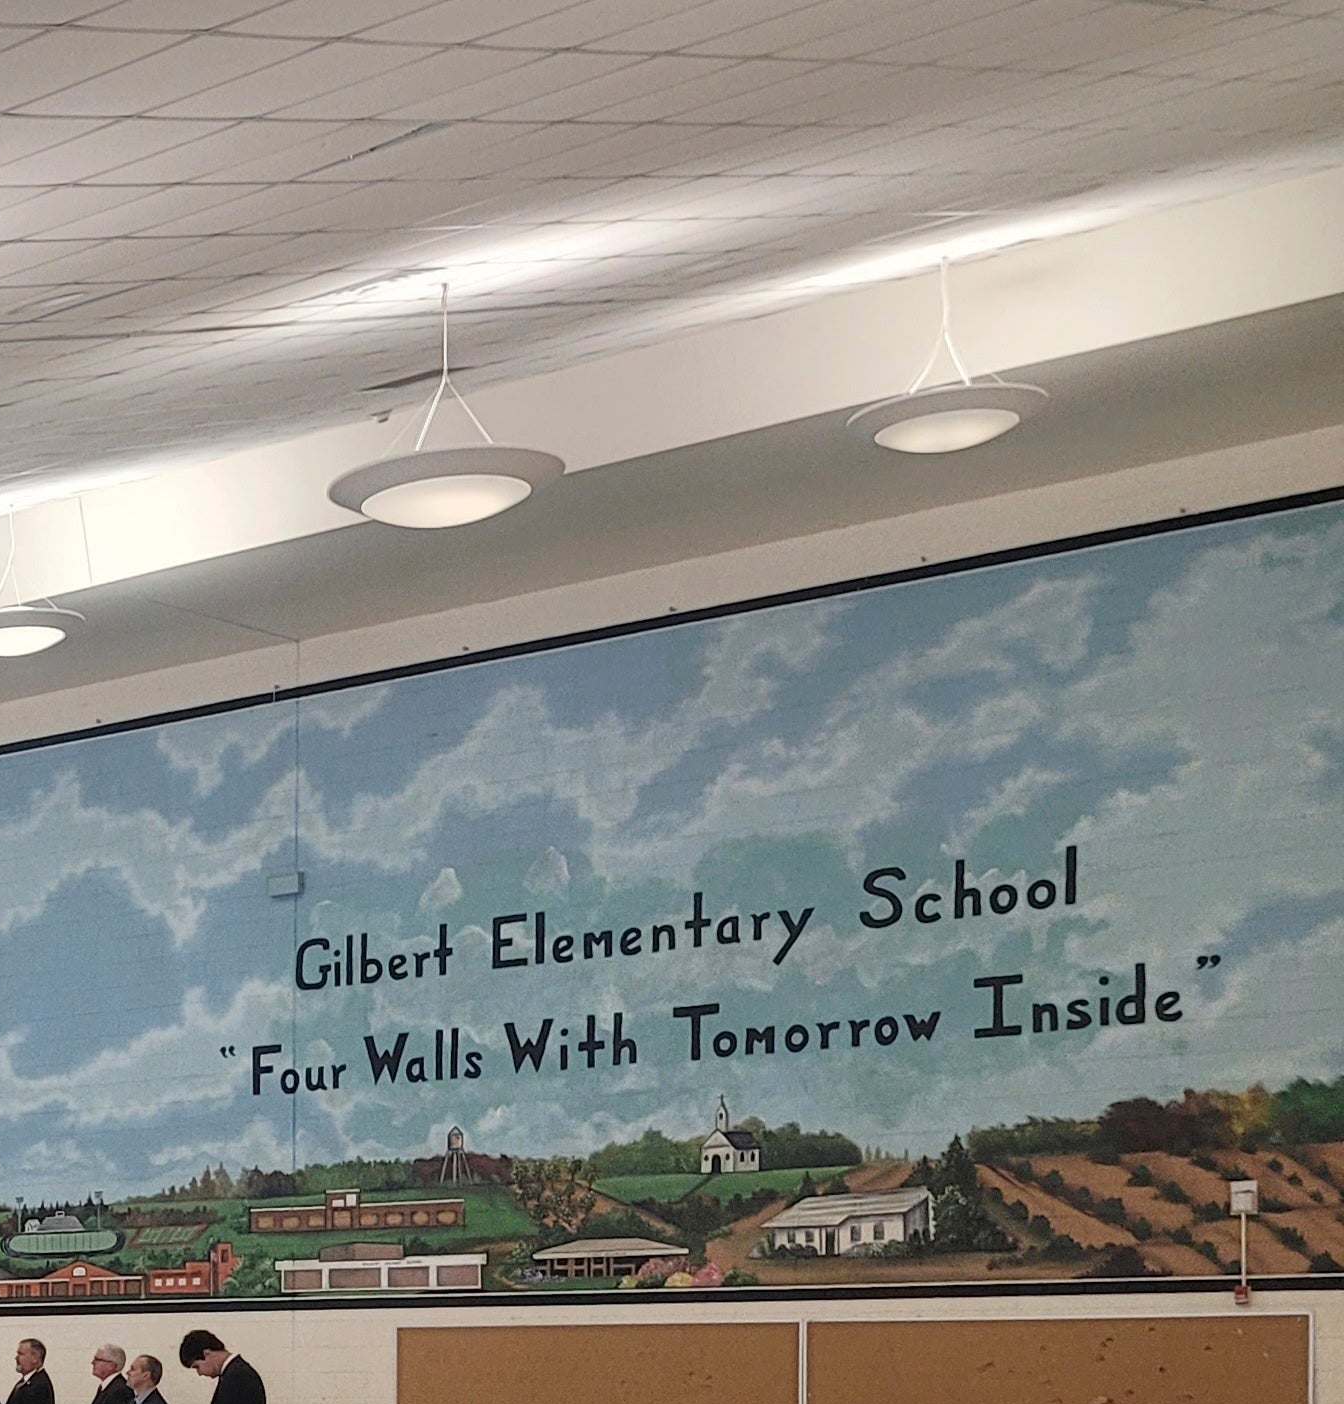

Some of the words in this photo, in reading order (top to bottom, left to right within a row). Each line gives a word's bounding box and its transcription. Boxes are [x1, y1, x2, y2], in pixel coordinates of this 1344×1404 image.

[294, 922, 454, 992] Gilbert
[490, 890, 816, 971] Elementary
[858, 844, 1079, 930] School
[362, 1028, 485, 1087] Walls
[502, 1011, 639, 1075] With
[671, 1001, 943, 1063] Tomorrow
